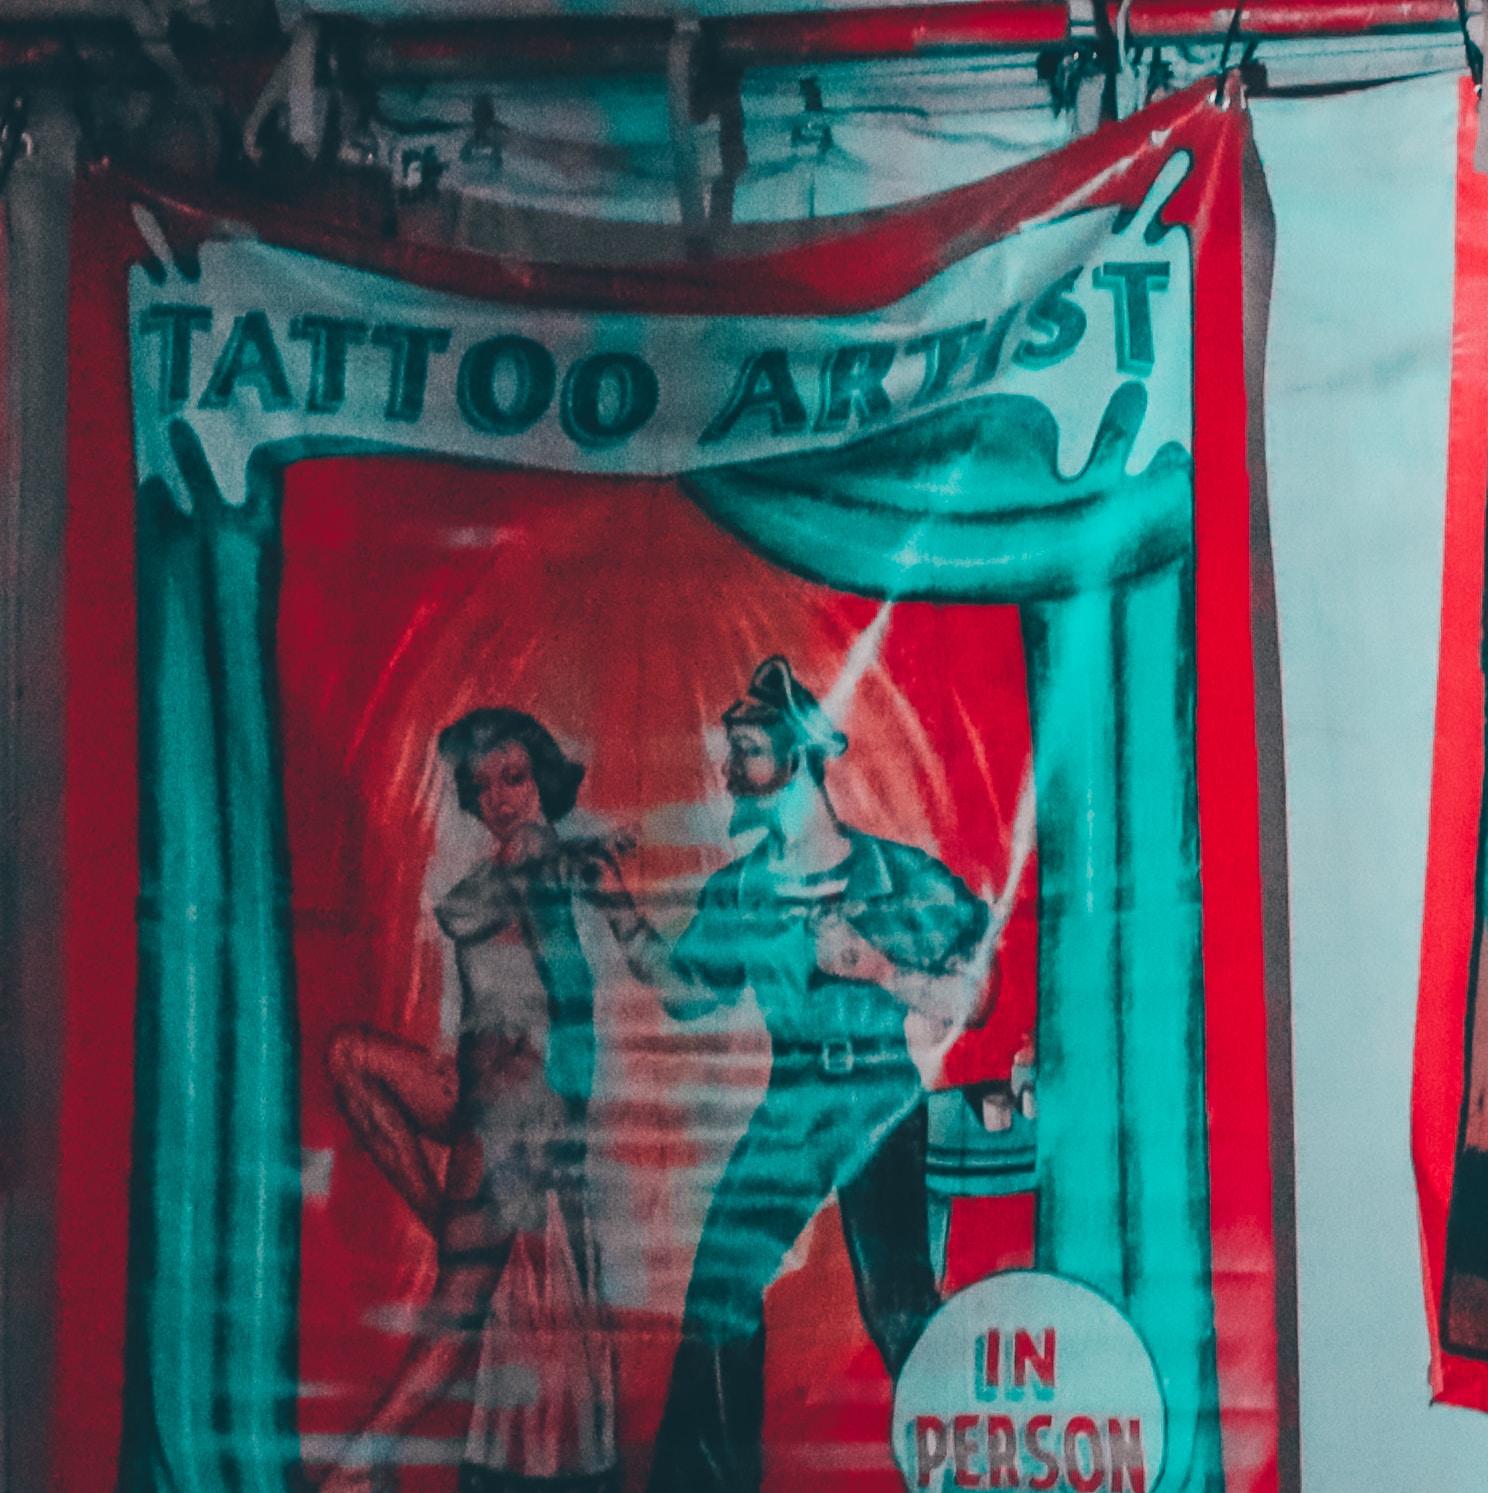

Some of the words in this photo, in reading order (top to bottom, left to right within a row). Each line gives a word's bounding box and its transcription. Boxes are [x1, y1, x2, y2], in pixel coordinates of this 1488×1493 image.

[137, 301, 661, 451] TATTOO
[696, 260, 1171, 448] ARTIST
[979, 1327, 1057, 1396] IN
